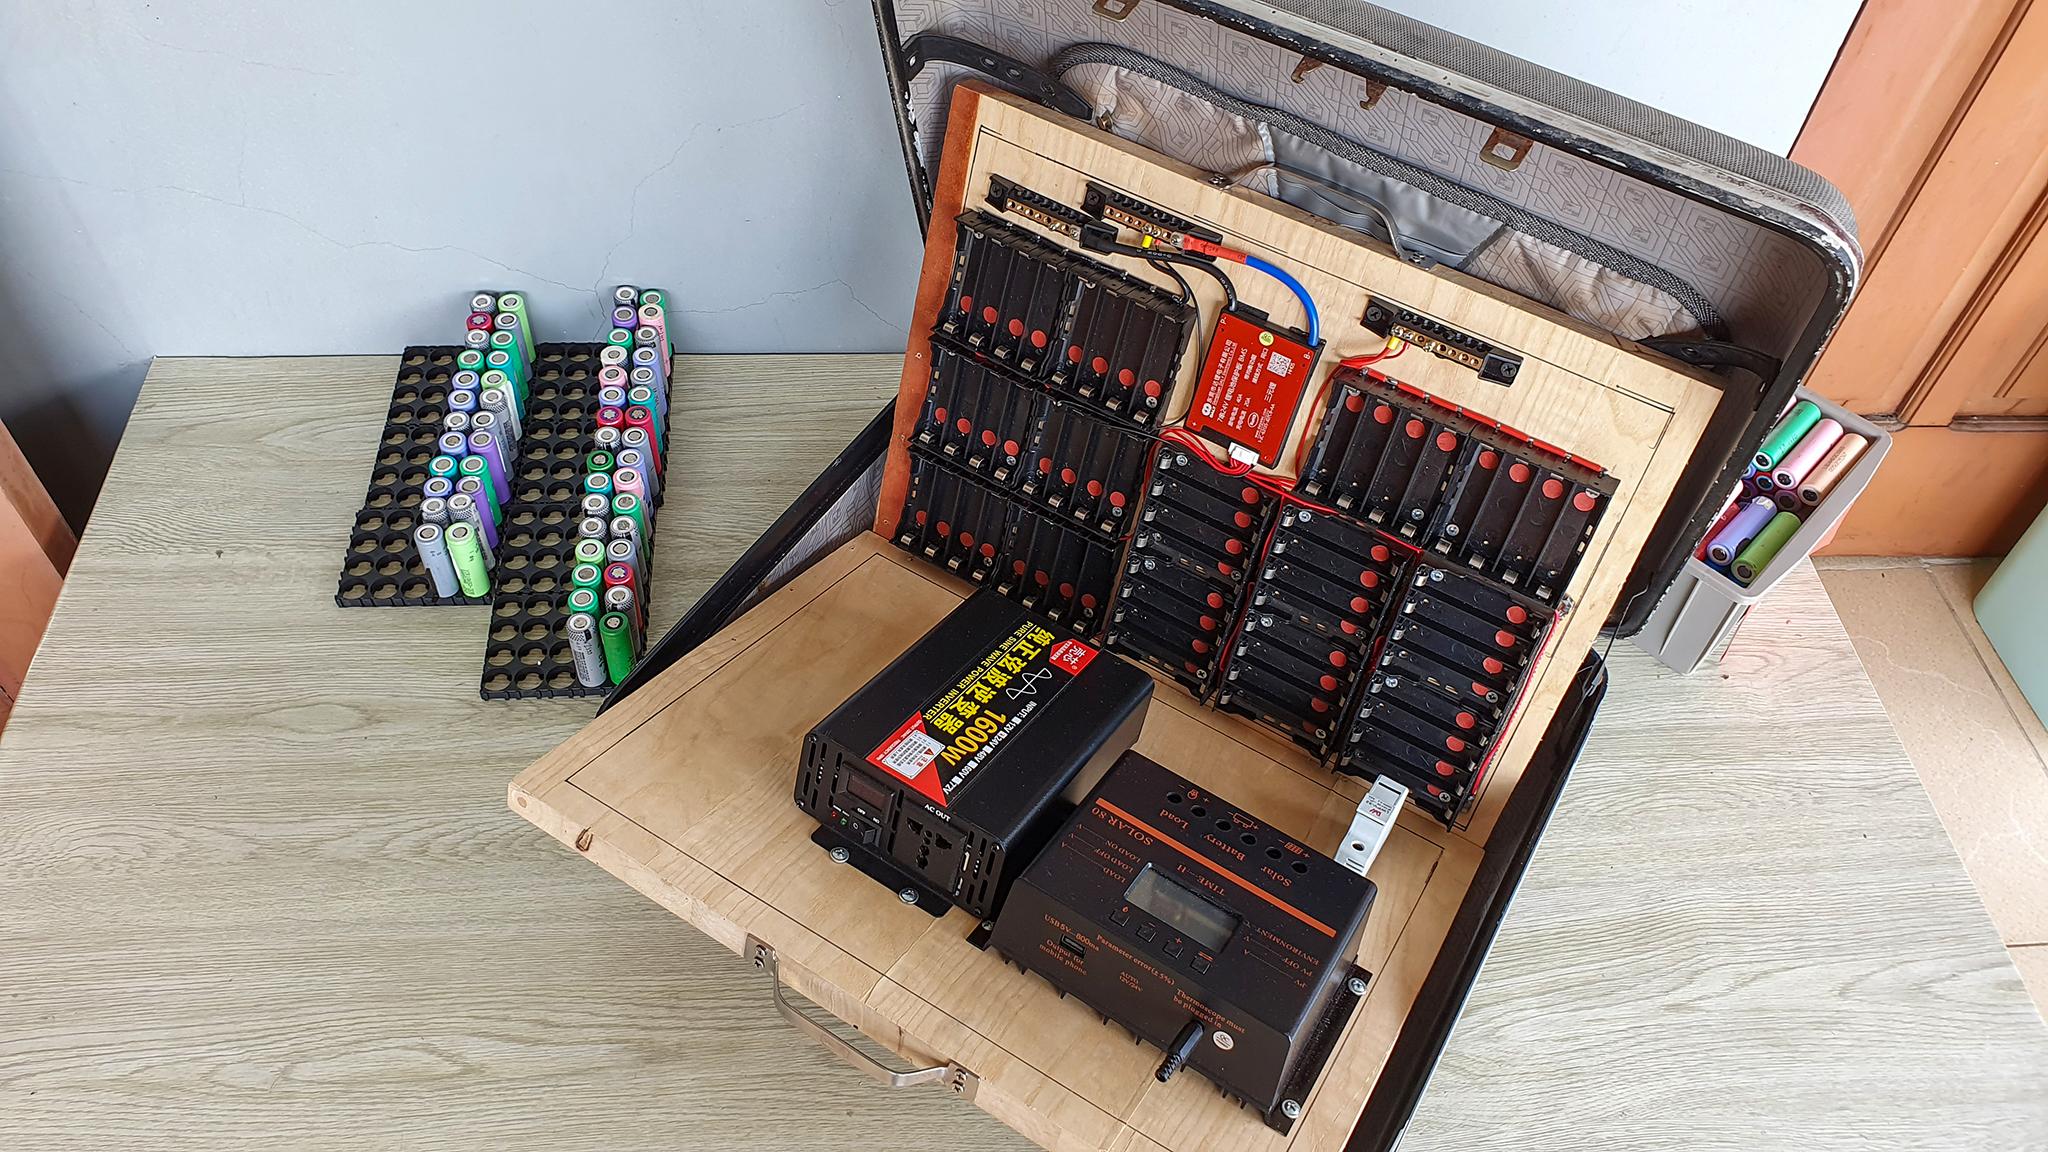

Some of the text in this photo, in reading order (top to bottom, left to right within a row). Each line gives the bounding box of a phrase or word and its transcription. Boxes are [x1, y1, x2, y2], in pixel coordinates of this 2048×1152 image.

[921, 618, 1033, 722] PURE SINE WAVE POWER INVERTER
[933, 621, 1054, 738] 纯正弦波逆变器
[939, 702, 1008, 770] 1600W
[941, 698, 1037, 795] INPUT: 12V 24V 48V 60V 72V
[924, 803, 952, 823] AC OUT
[1157, 807, 1190, 829] Load
[1103, 838, 1118, 850] ON
[1106, 815, 1153, 846] SOLAR
[1093, 846, 1111, 860] OFF
[1116, 846, 1141, 863] LOAD
[1202, 830, 1246, 861] Battery
[1101, 866, 1126, 883] LOAD
[1109, 856, 1134, 873] LOAD
[1257, 863, 1293, 888] Solar
[1037, 943, 1064, 962] mobile
[1094, 933, 1134, 962] Parameter
[1253, 925, 1319, 966] ENVIRONMENT
[1172, 995, 1183, 1005] be
[1182, 1001, 1213, 1024] plugged
[1174, 988, 1246, 1034] Thermoscope must
